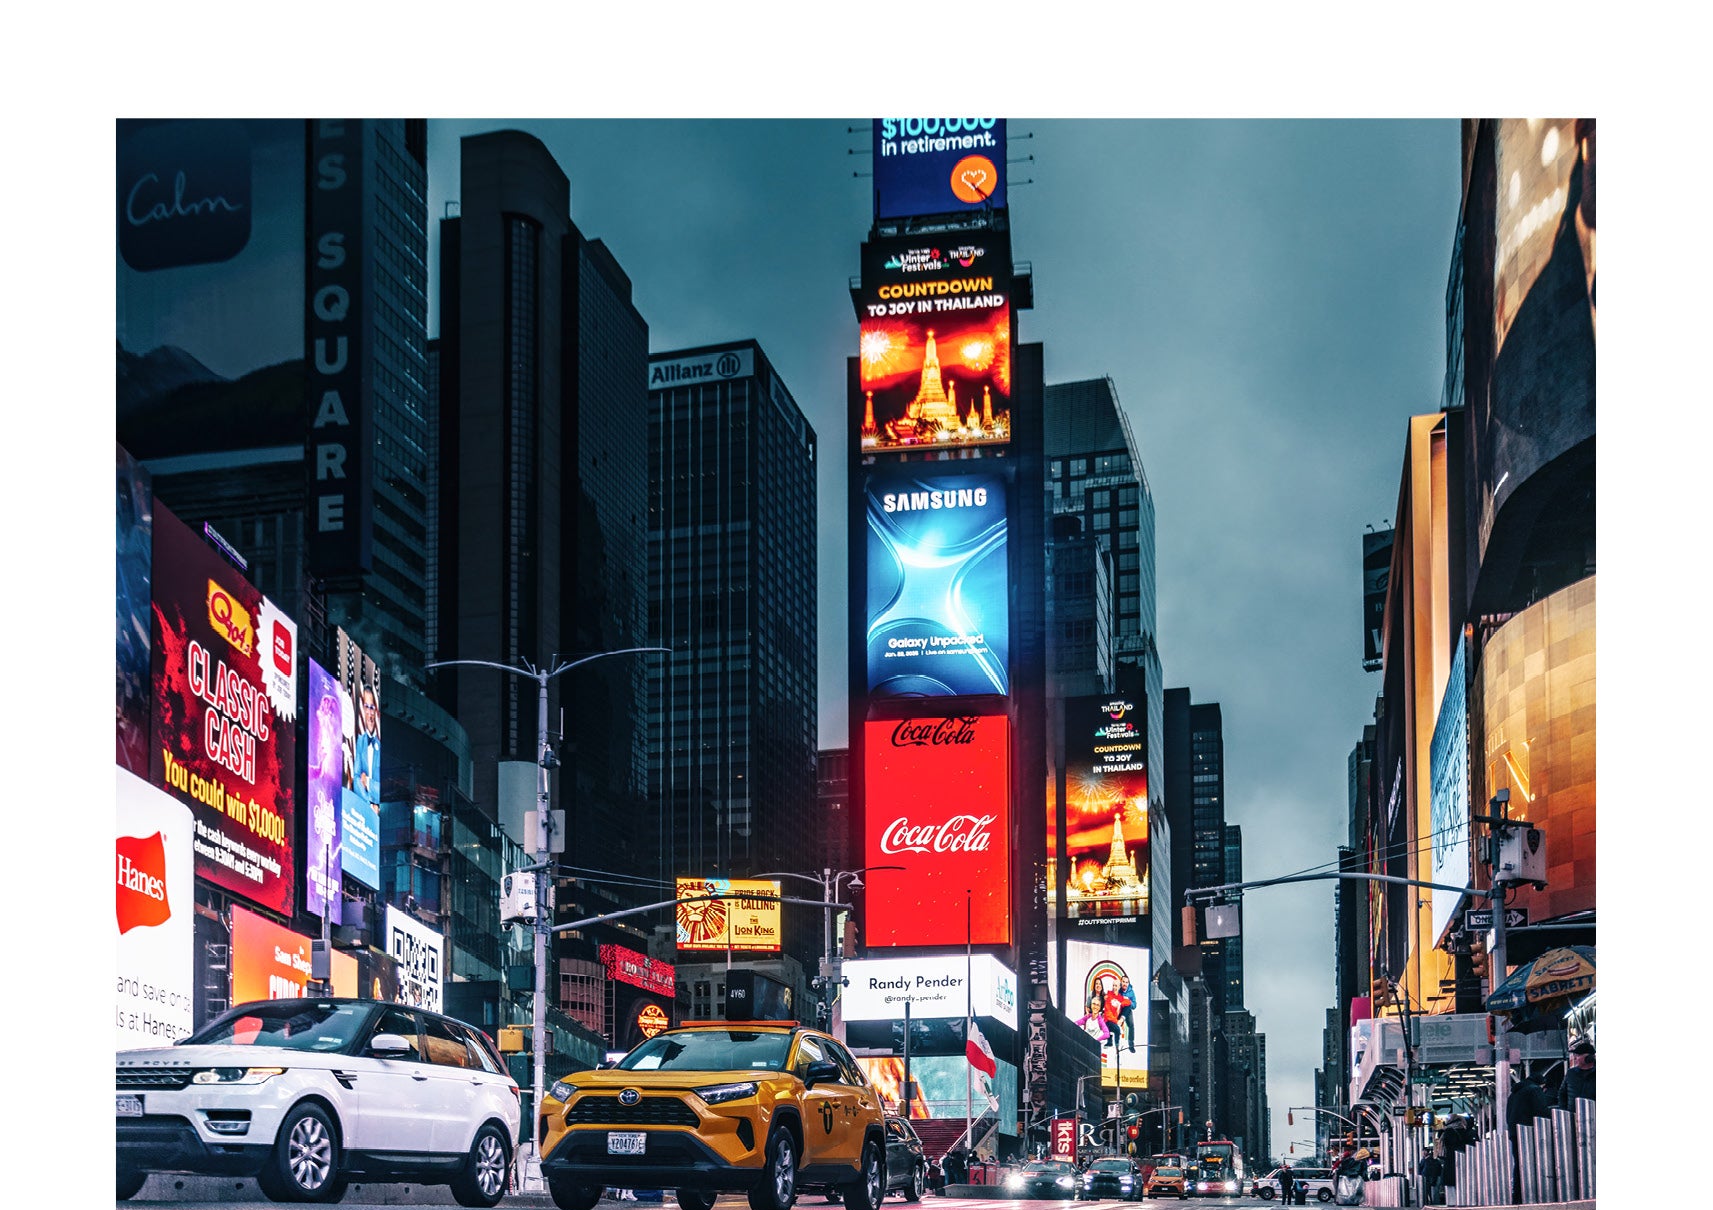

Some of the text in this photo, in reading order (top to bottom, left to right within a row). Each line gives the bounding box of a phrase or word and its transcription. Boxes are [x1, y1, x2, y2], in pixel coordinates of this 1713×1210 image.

[881, 131, 996, 157] in retirement.
[126, 172, 243, 226] Calm
[902, 259, 942, 273] Festivals
[878, 276, 993, 300] COUNTDOWN
[867, 294, 1004, 318] TO JOY IN THAILAND
[312, 231, 351, 533] SQUARE
[651, 358, 713, 385] Allianz
[883, 487, 987, 513] SAMSUNG
[888, 633, 984, 650] Galaxy Unpacked
[187, 639, 269, 742] CLASSIC
[1101, 703, 1134, 713] THAILAND
[891, 716, 980, 747] Coca-Cola
[203, 706, 256, 785] CASH
[1093, 743, 1142, 754] COUNTDOWN
[1115, 754, 1133, 762] JOY
[1093, 763, 1143, 774] IN THAILAND
[162, 749, 189, 794] You
[189, 776, 225, 813] could
[226, 795, 247, 827] win
[248, 801, 286, 848] $1,000!
[197, 819, 208, 838] the
[207, 828, 222, 846] cash
[880, 814, 998, 855] Coca-Cola
[117, 853, 165, 902] Hanes
[741, 898, 775, 911] CALLING
[734, 925, 775, 936] LION KING
[1475, 916, 1491, 924] ON
[274, 945, 292, 967] Sam
[117, 974, 140, 998] and
[142, 981, 166, 1002] save
[869, 975, 964, 992] Randy Pender
[1529, 974, 1594, 999] SABRETT
[128, 1013, 139, 1031] at
[1057, 1121, 1073, 1154] tkts
